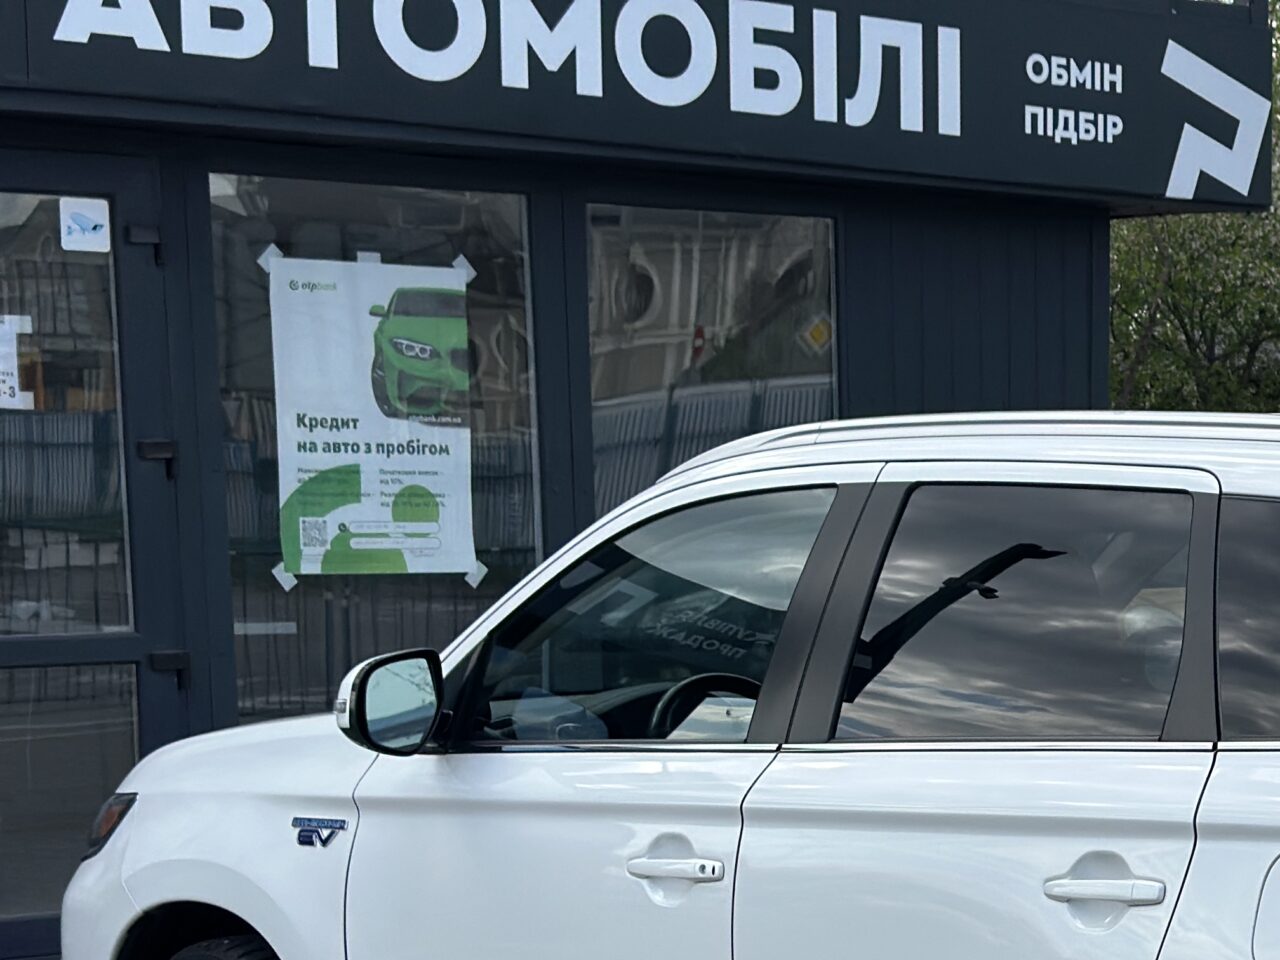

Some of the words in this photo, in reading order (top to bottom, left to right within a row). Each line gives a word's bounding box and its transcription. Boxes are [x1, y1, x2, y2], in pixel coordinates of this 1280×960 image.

[1026, 53, 1122, 93] ОБМІН
[1025, 104, 1123, 145] ПІДБІР
[296, 413, 359, 432] Кредит
[297, 441, 318, 453] на
[322, 441, 360, 454] авто
[364, 442, 372, 454] з
[376, 438, 450, 458] пробігом
